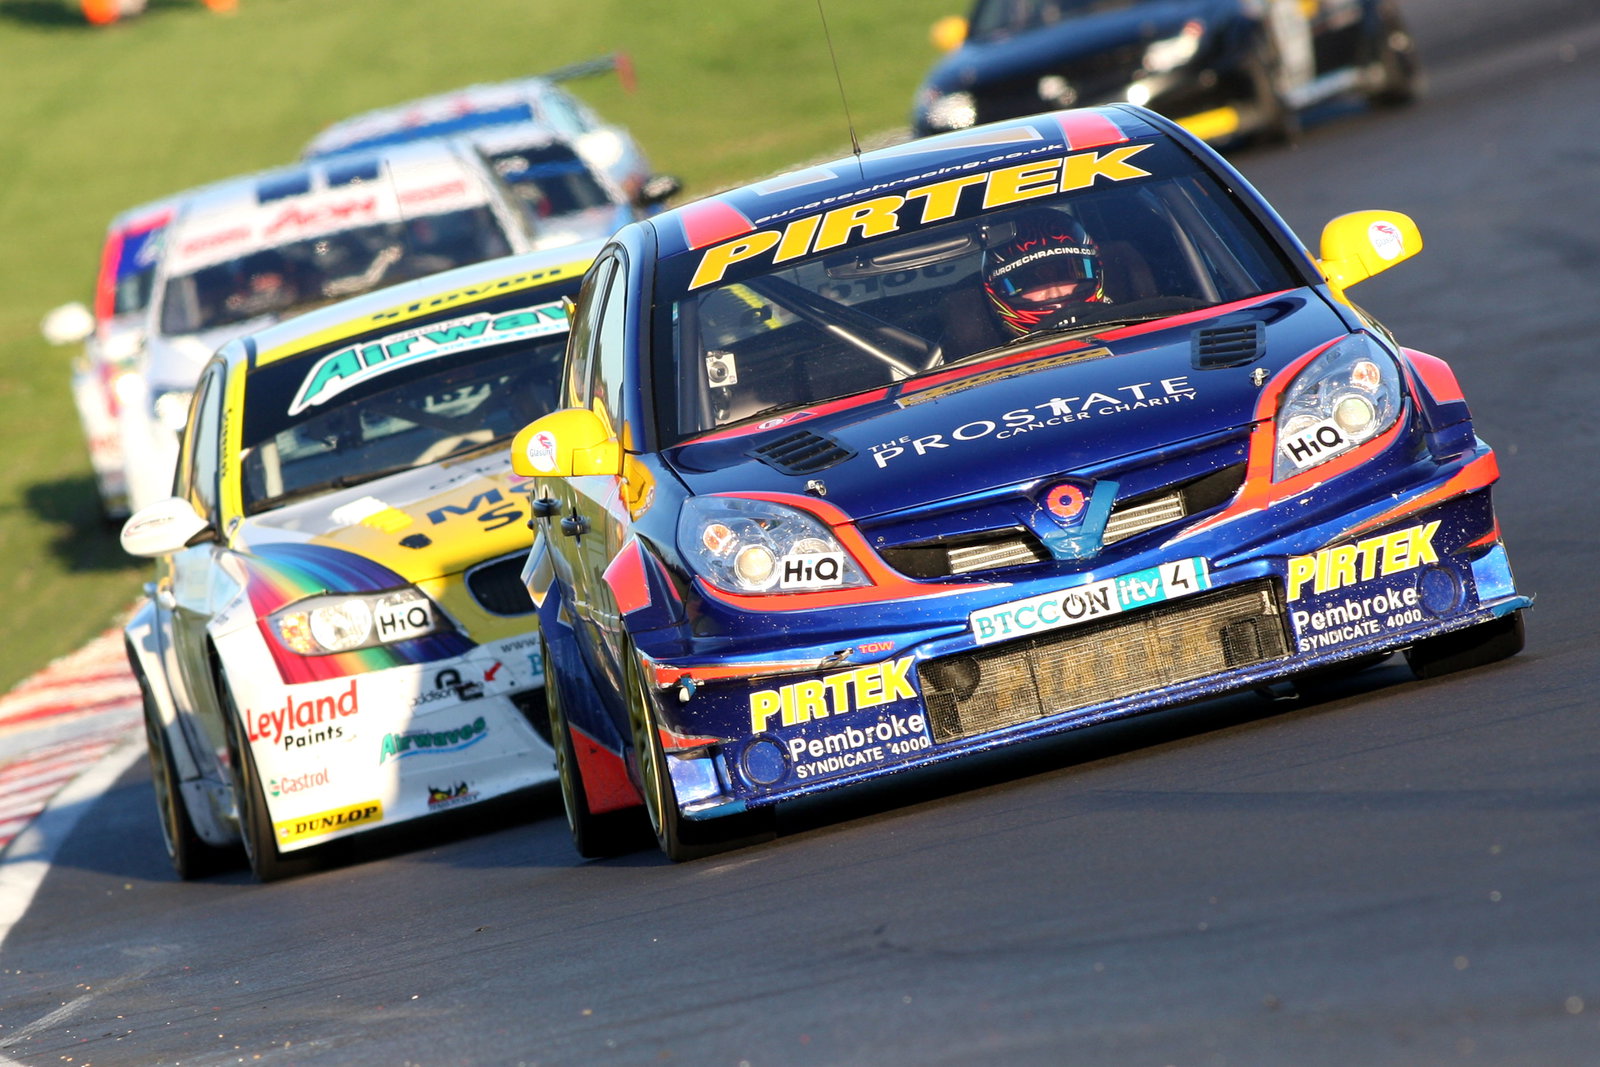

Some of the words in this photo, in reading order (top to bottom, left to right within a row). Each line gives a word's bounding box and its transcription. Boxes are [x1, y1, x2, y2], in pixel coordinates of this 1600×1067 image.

[687, 143, 1155, 291] PIRTEK
[873, 376, 1196, 468] PROSTATE
[996, 409, 1096, 440] CANCER
[1098, 391, 1197, 416] CHARITY
[868, 435, 911, 453] THE
[1287, 426, 1344, 462] HiQ
[783, 558, 839, 584] HiQ
[1286, 519, 1442, 602] PIRTEK
[380, 607, 429, 635] HiQ
[976, 601, 1060, 639] BTCC
[1119, 575, 1159, 605] itv
[1171, 564, 1189, 590] 4
[1293, 586, 1418, 635] Pembroke
[858, 641, 895, 654] TOW
[1300, 620, 1380, 653] SYNDICATE
[1387, 607, 1422, 629] 4000
[246, 679, 358, 745] Leyland
[749, 655, 918, 735] PIRTEK
[284, 725, 344, 751] Paints
[788, 712, 925, 763] Pembroke
[795, 746, 884, 780] SYNDICATE
[891, 736, 930, 755] 4000
[281, 768, 330, 794] Castrol
[296, 805, 378, 835] DUNLOP
